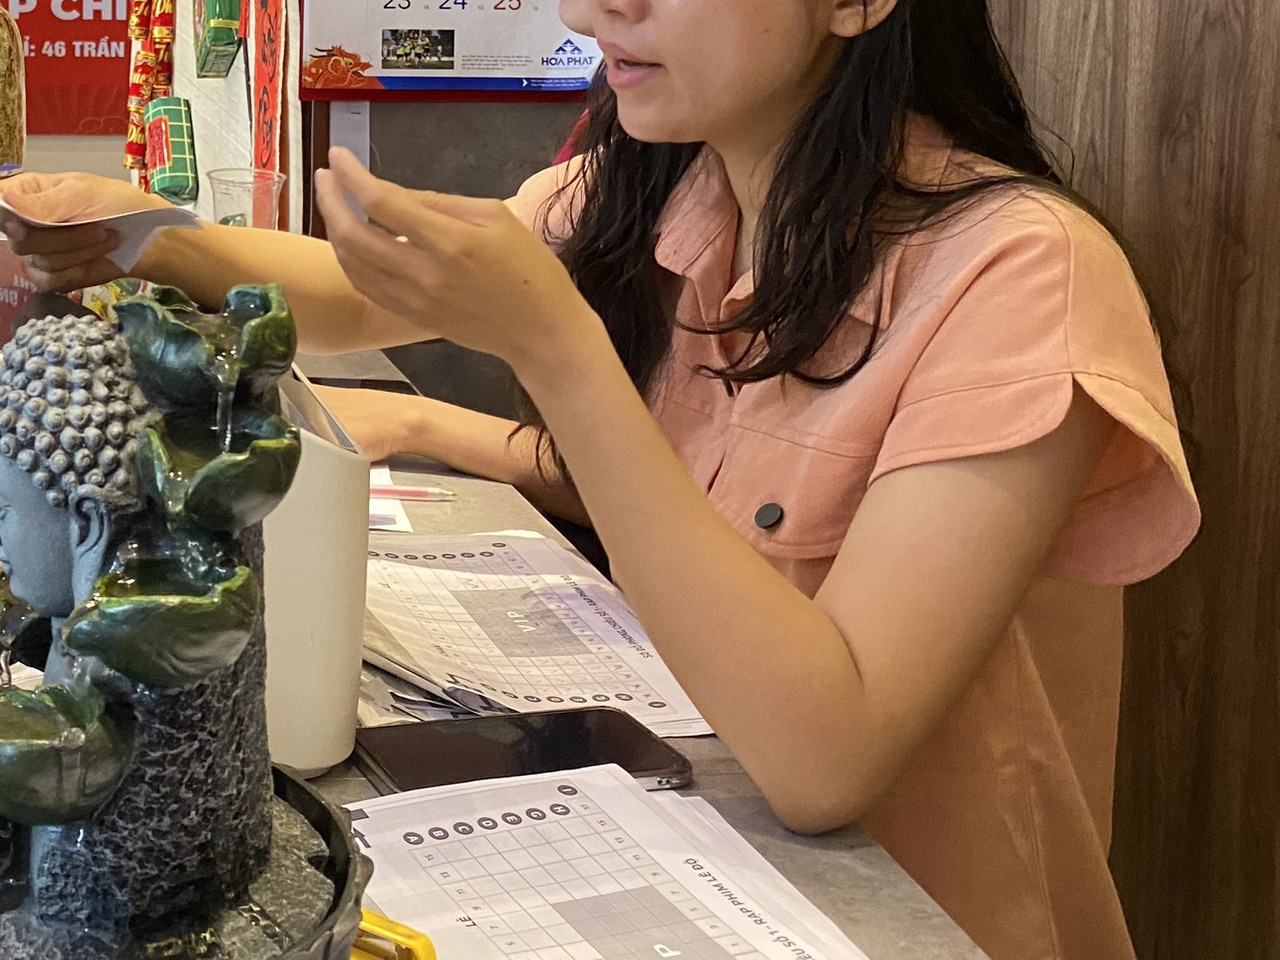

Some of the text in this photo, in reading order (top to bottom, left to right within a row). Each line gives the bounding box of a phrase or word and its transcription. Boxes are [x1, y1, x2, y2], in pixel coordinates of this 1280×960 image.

[42, 41, 66, 57] 46
[72, 35, 125, 58] TRẦN
[507, 611, 536, 633] VIP
[712, 883, 744, 906] PHIM
[740, 907, 768, 926] RẠP
[772, 935, 796, 948] SỐ
